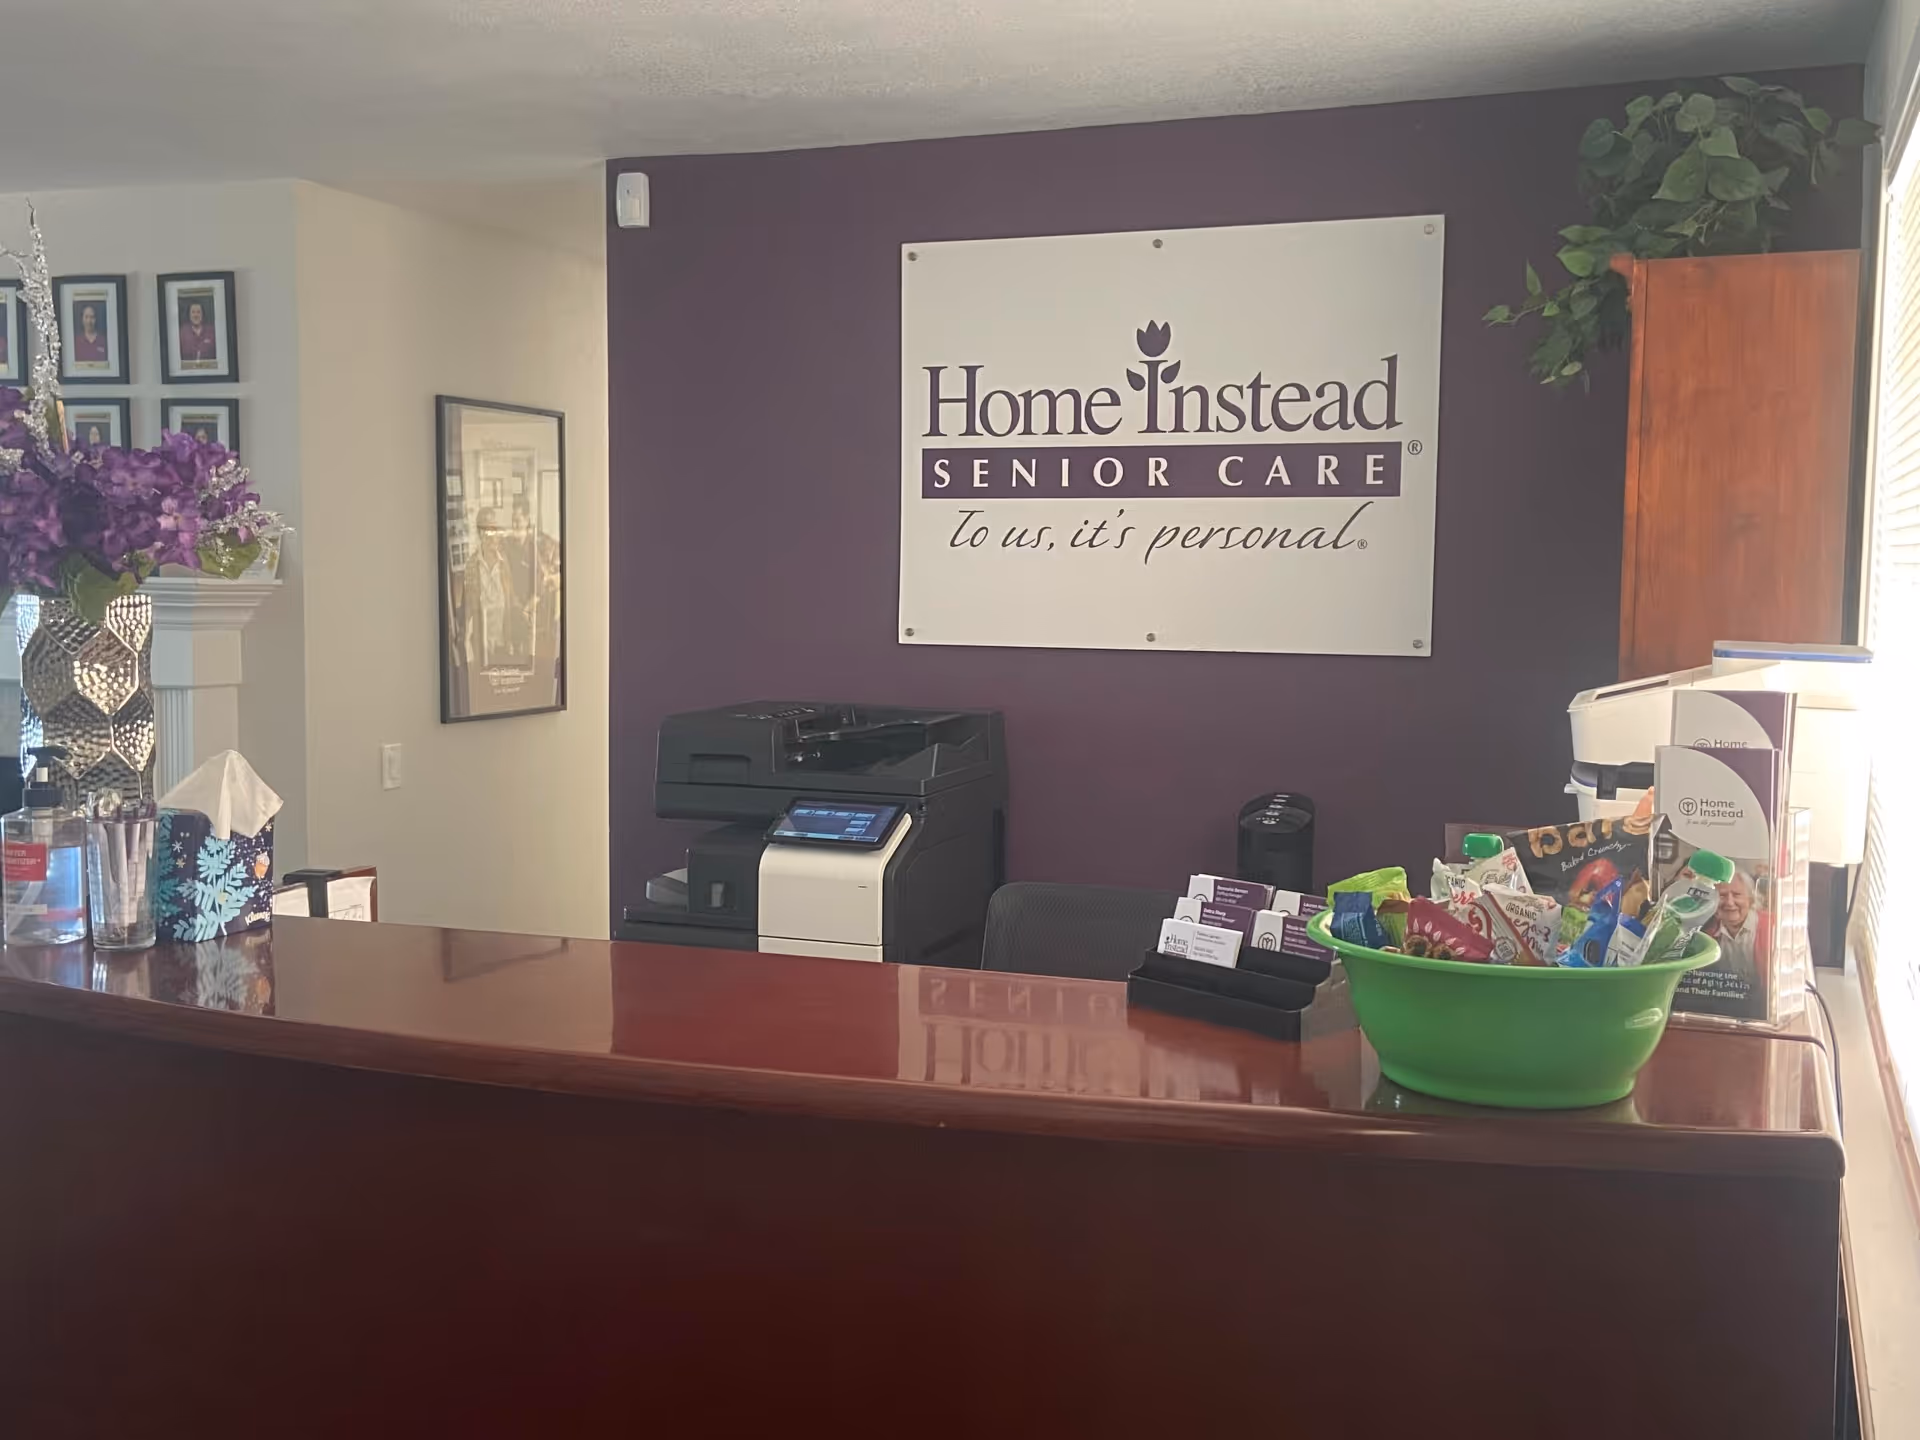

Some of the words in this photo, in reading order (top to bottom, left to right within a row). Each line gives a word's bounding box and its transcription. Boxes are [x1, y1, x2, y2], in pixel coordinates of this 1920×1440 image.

[921, 364, 1123, 438] Home
[1136, 353, 1404, 435] Instead
[932, 455, 1170, 489] SENIOR
[1217, 453, 1386, 487] CARE
[948, 508, 988, 550] To
[1069, 508, 1135, 549] it's
[1699, 798, 1737, 808] Home
[1699, 808, 1745, 818] Instead
[1560, 852, 1585, 872] Baked
[1505, 903, 1538, 921] ORGANIC
[1691, 987, 1711, 996] Their
